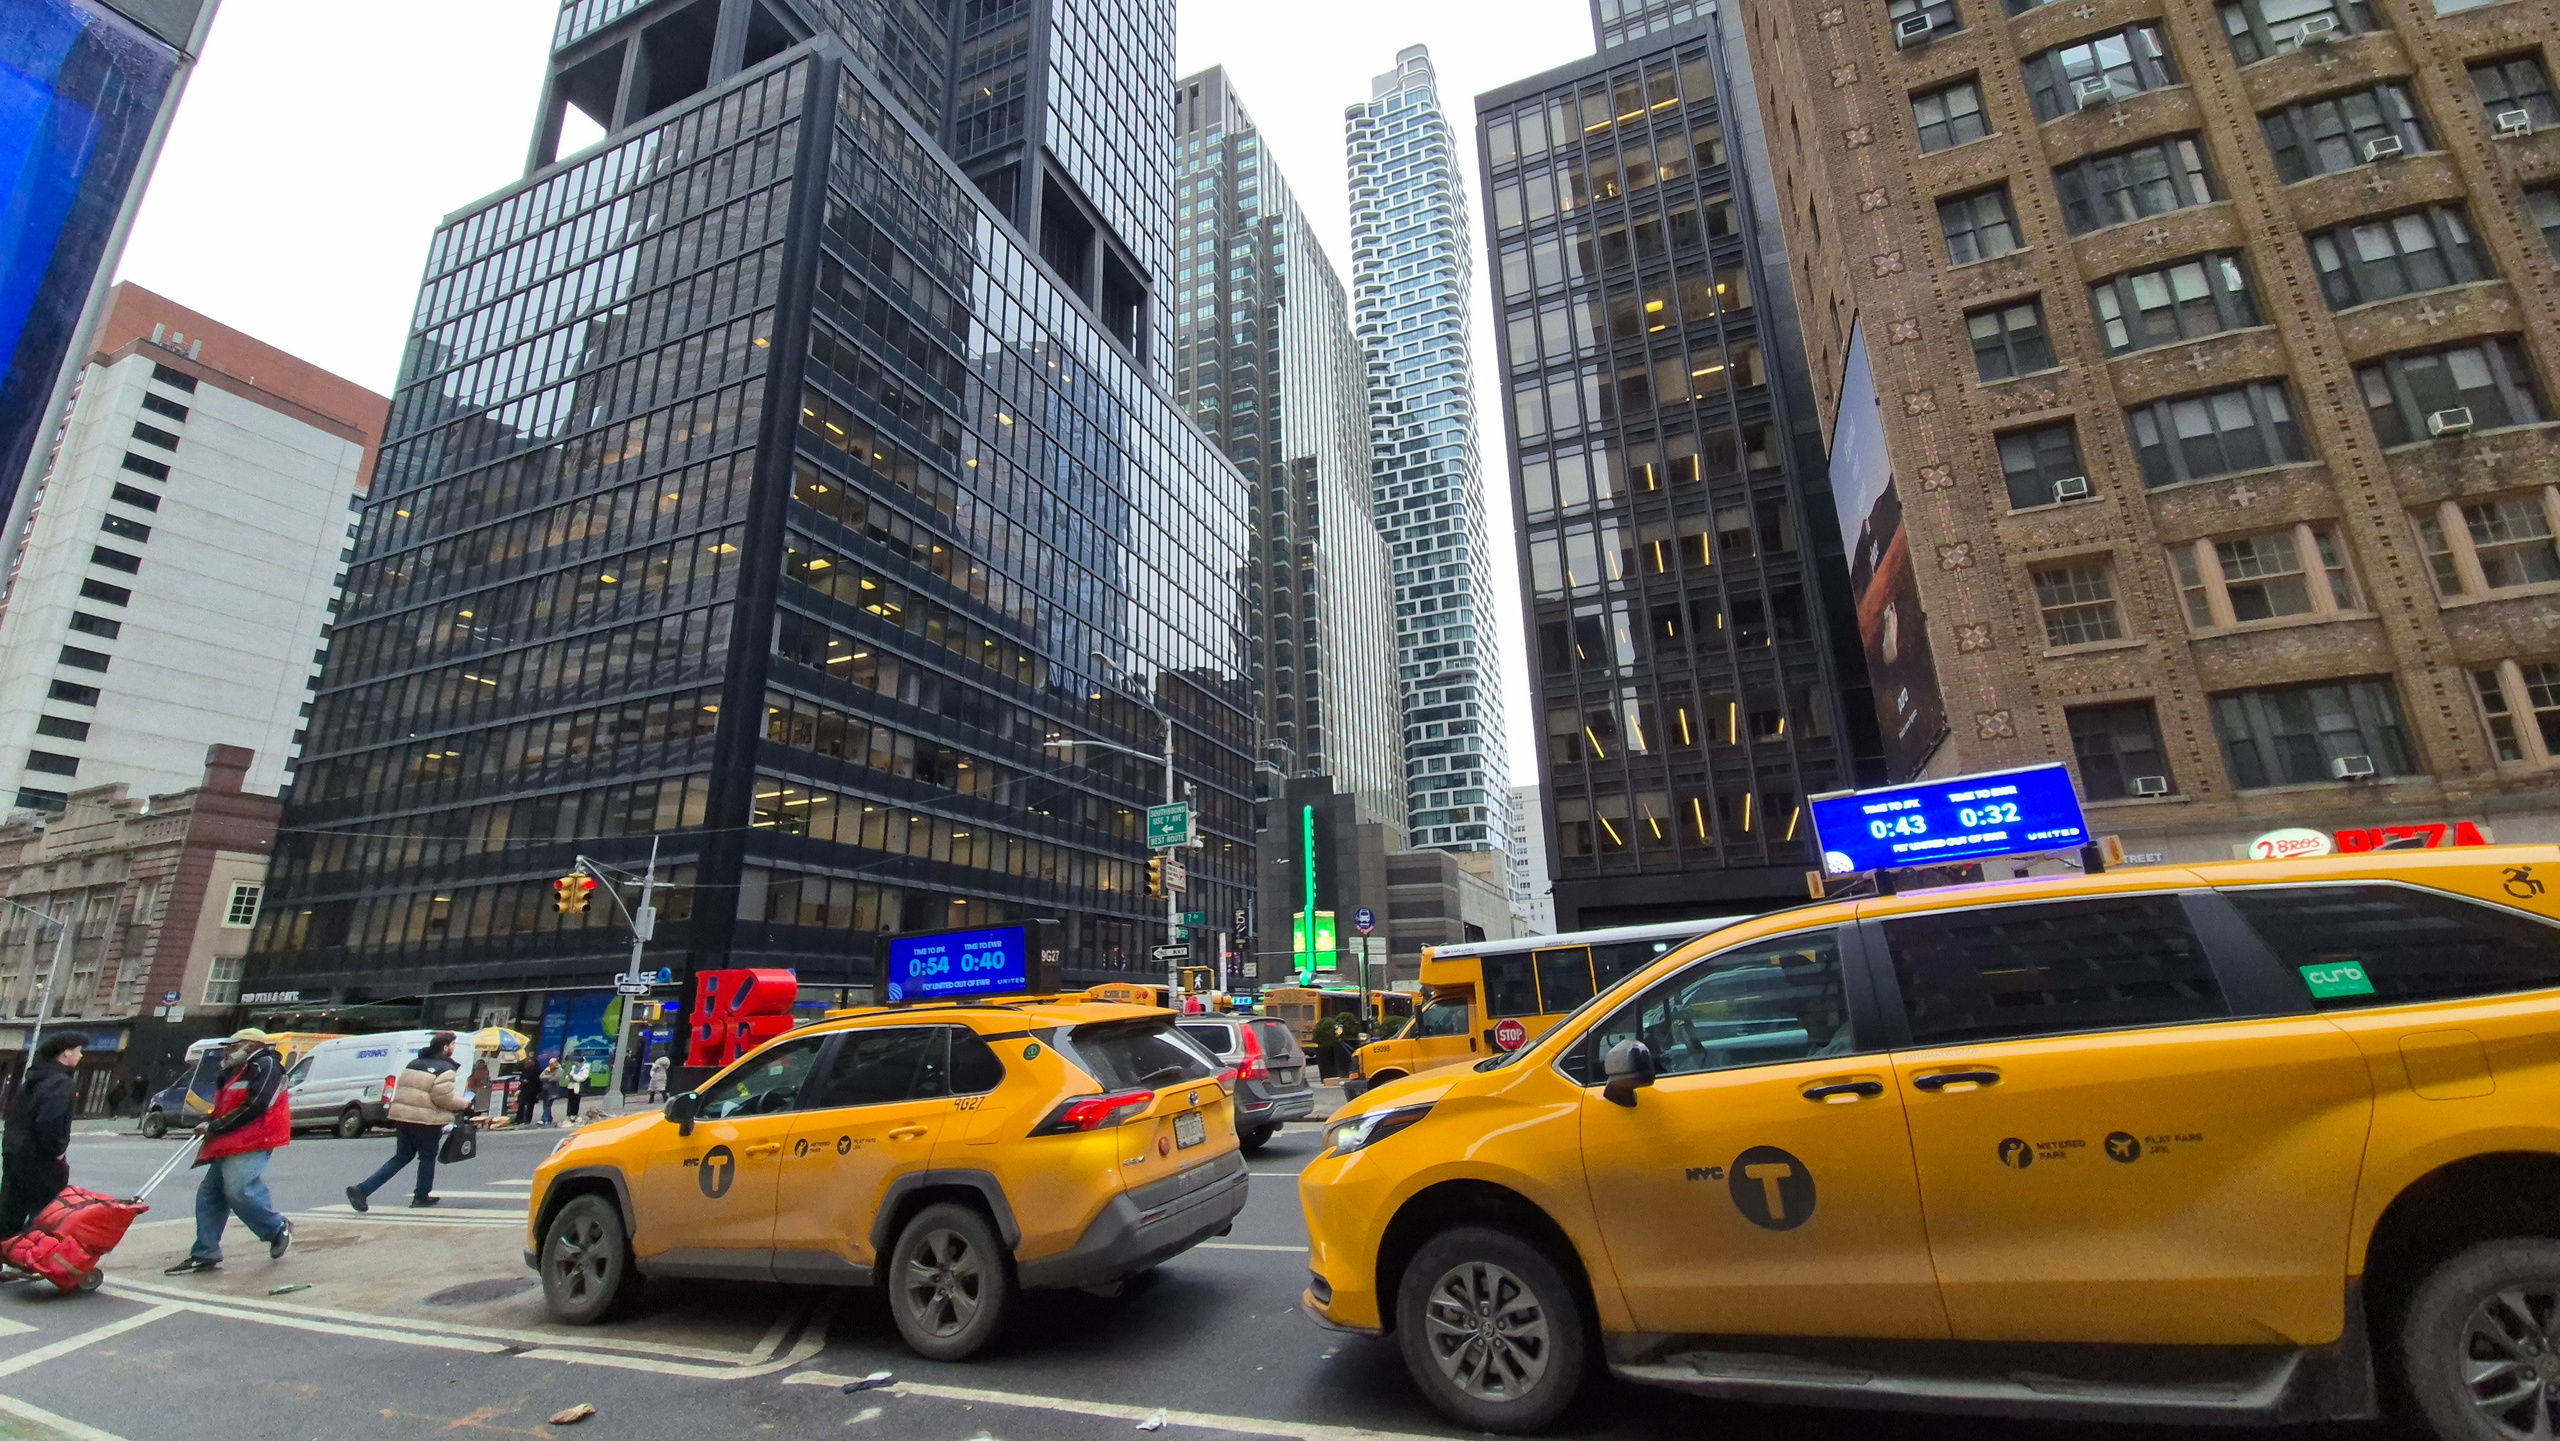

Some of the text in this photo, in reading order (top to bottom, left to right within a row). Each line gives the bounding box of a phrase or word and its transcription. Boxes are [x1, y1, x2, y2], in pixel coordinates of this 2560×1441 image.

[1975, 789, 1991, 799] TO
[1150, 805, 1185, 817] SOUTHBOUND
[1887, 801, 1903, 811] TO
[1152, 814, 1182, 825] USE 7 AVE
[1960, 802, 2021, 827] 0:32
[1871, 815, 1927, 839] 0:43
[1151, 833, 1185, 846] BEST ROUTE
[2027, 827, 2080, 841] UNITED
[2256, 840, 2276, 859] 2
[2124, 852, 2162, 864] TREET
[1187, 913, 1192, 923] 7
[964, 943, 979, 951] TIME
[988, 940, 1002, 948] EWR
[913, 948, 928, 956] TIME
[1041, 950, 1060, 962] 9G27
[1156, 949, 1168, 957] ONE
[909, 956, 950, 977] 0:54
[960, 951, 1005, 972] 0:40
[997, 977, 1025, 985] UNITED
[2309, 967, 2362, 984] curb
[922, 983, 932, 991] FLY
[932, 981, 954, 990] UNITED
[954, 980, 967, 988] OUT
[967, 979, 976, 987] OF
[1499, 1029, 1523, 1042] STOP
[954, 1096, 986, 1112] 9G27
[2144, 1132, 2204, 1144] FLAT FARE
[2036, 1139, 2086, 1150] METERED
[2038, 1151, 2067, 1160] FARE
[683, 1155, 728, 1192] NYC T
[1685, 1162, 1792, 1220] NYC T
